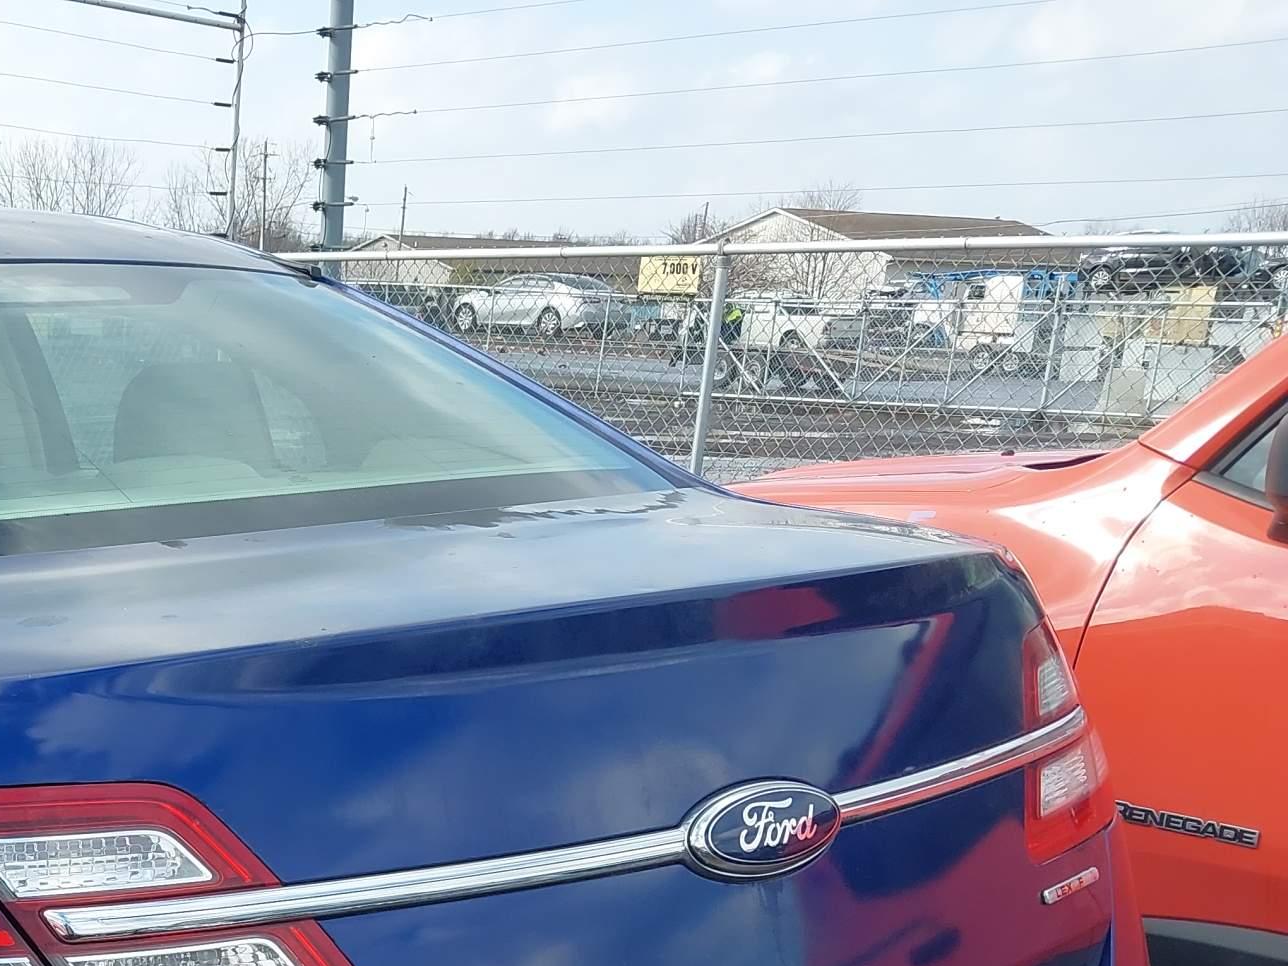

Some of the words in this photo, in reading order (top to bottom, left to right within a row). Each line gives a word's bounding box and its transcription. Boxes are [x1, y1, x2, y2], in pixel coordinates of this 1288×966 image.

[662, 262, 689, 276] 7,000
[691, 263, 698, 275] V
[739, 797, 818, 853] Ford
[1115, 800, 1260, 848] RENEGADE
